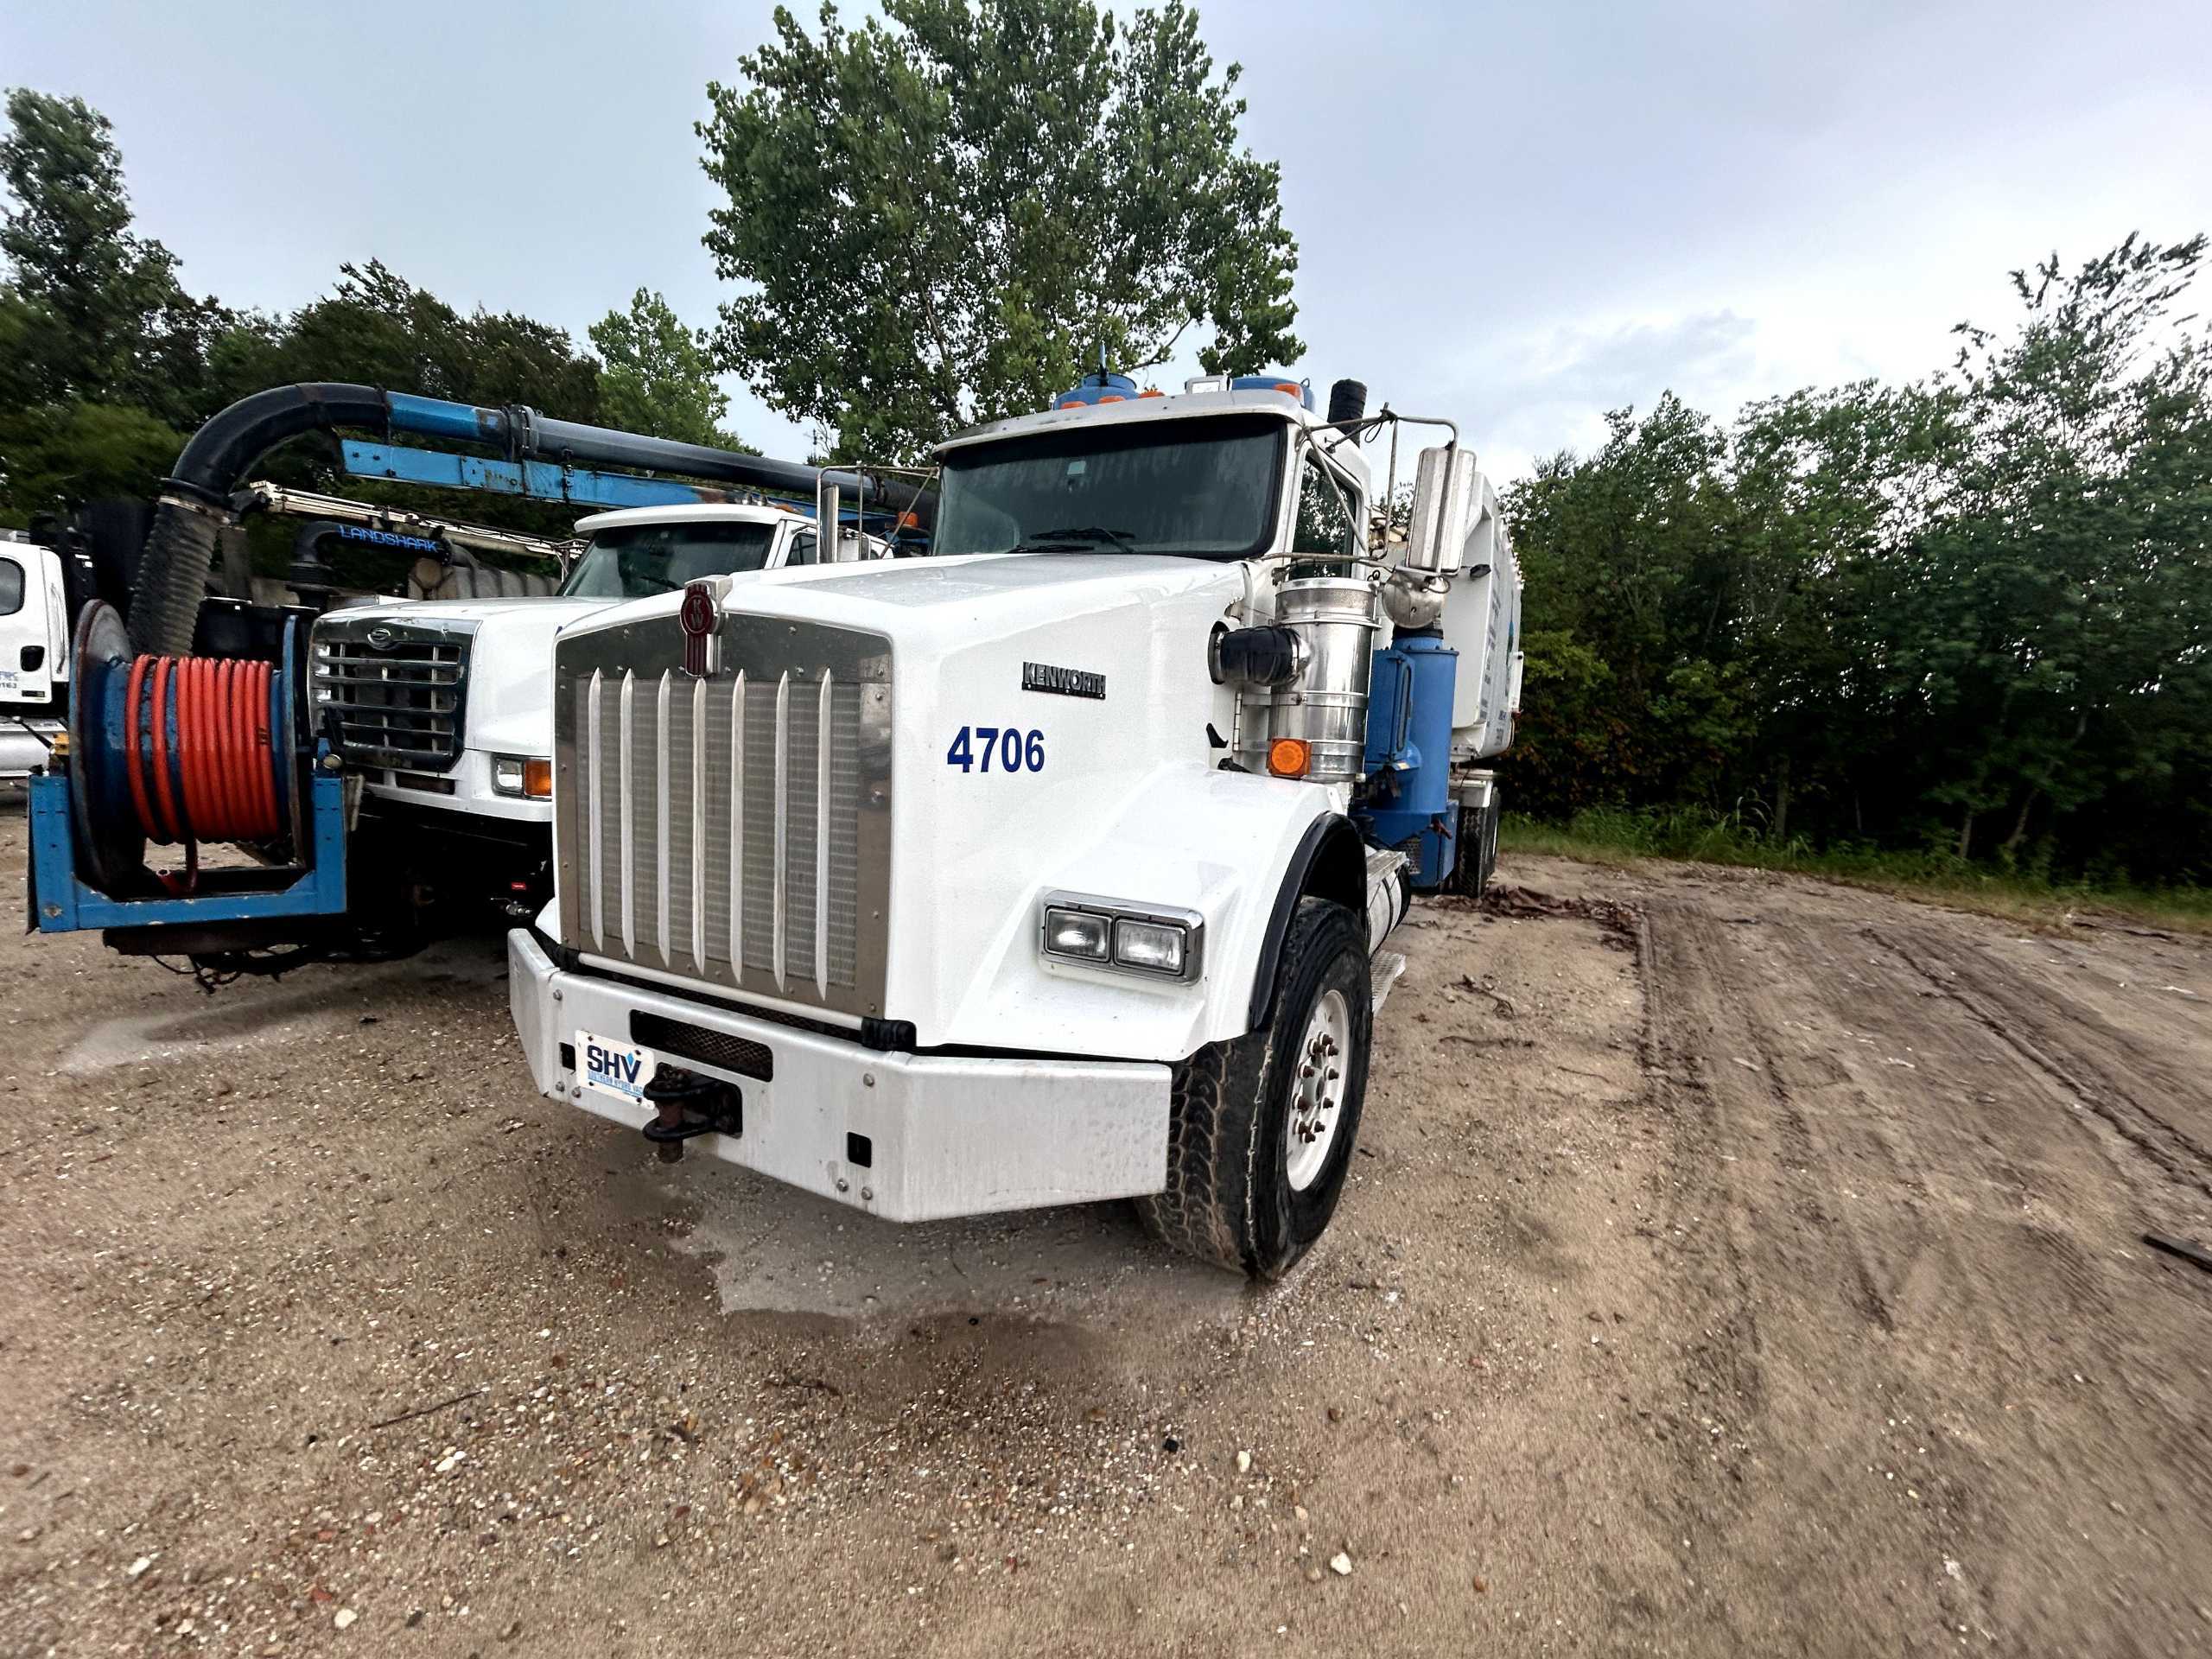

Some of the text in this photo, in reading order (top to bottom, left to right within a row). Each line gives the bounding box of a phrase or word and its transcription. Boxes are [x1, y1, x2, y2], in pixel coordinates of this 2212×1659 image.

[340, 524, 438, 552] LANDSHARK
[1023, 662, 1106, 694] KENWORTH
[947, 726, 1045, 772] 4706
[588, 1045, 641, 1084] SHV
